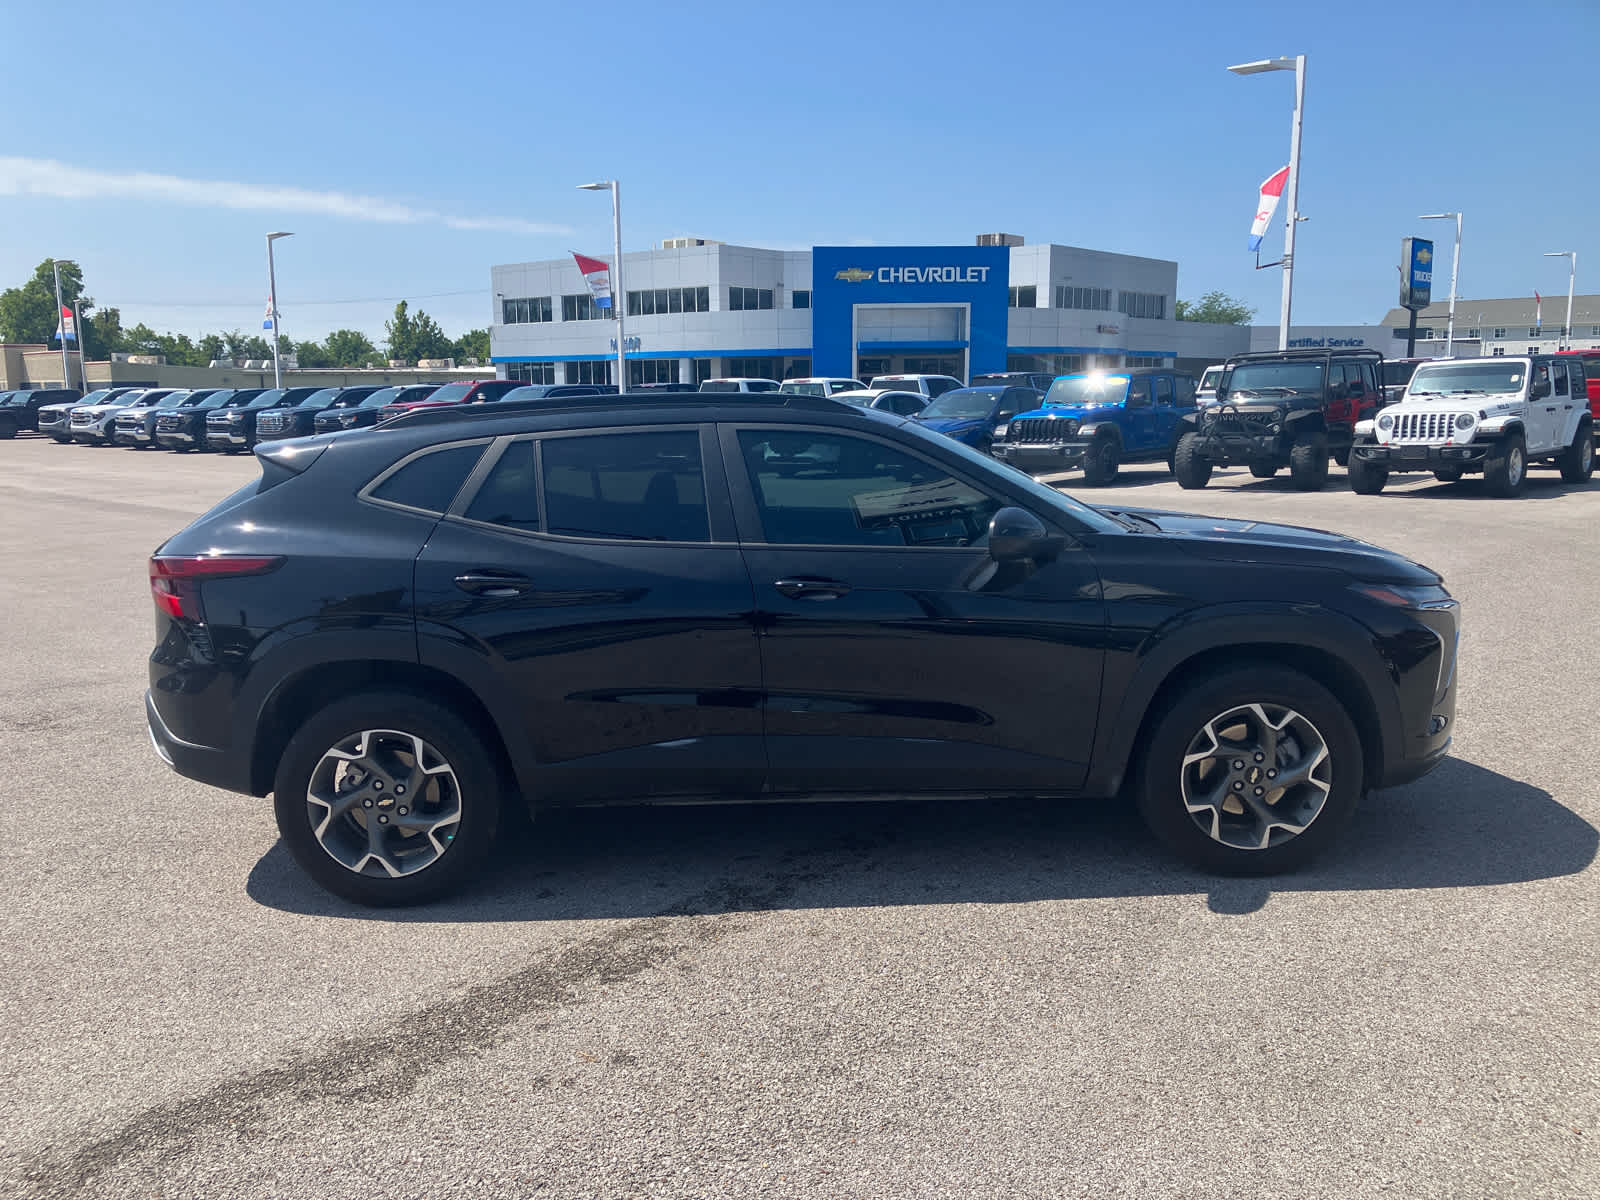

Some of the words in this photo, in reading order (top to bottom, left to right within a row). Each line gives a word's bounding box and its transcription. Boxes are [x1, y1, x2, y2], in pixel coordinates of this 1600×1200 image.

[877, 266, 990, 282] CHEVROLET
[1288, 337, 1324, 347] ertified
[1327, 337, 1364, 347] Service
